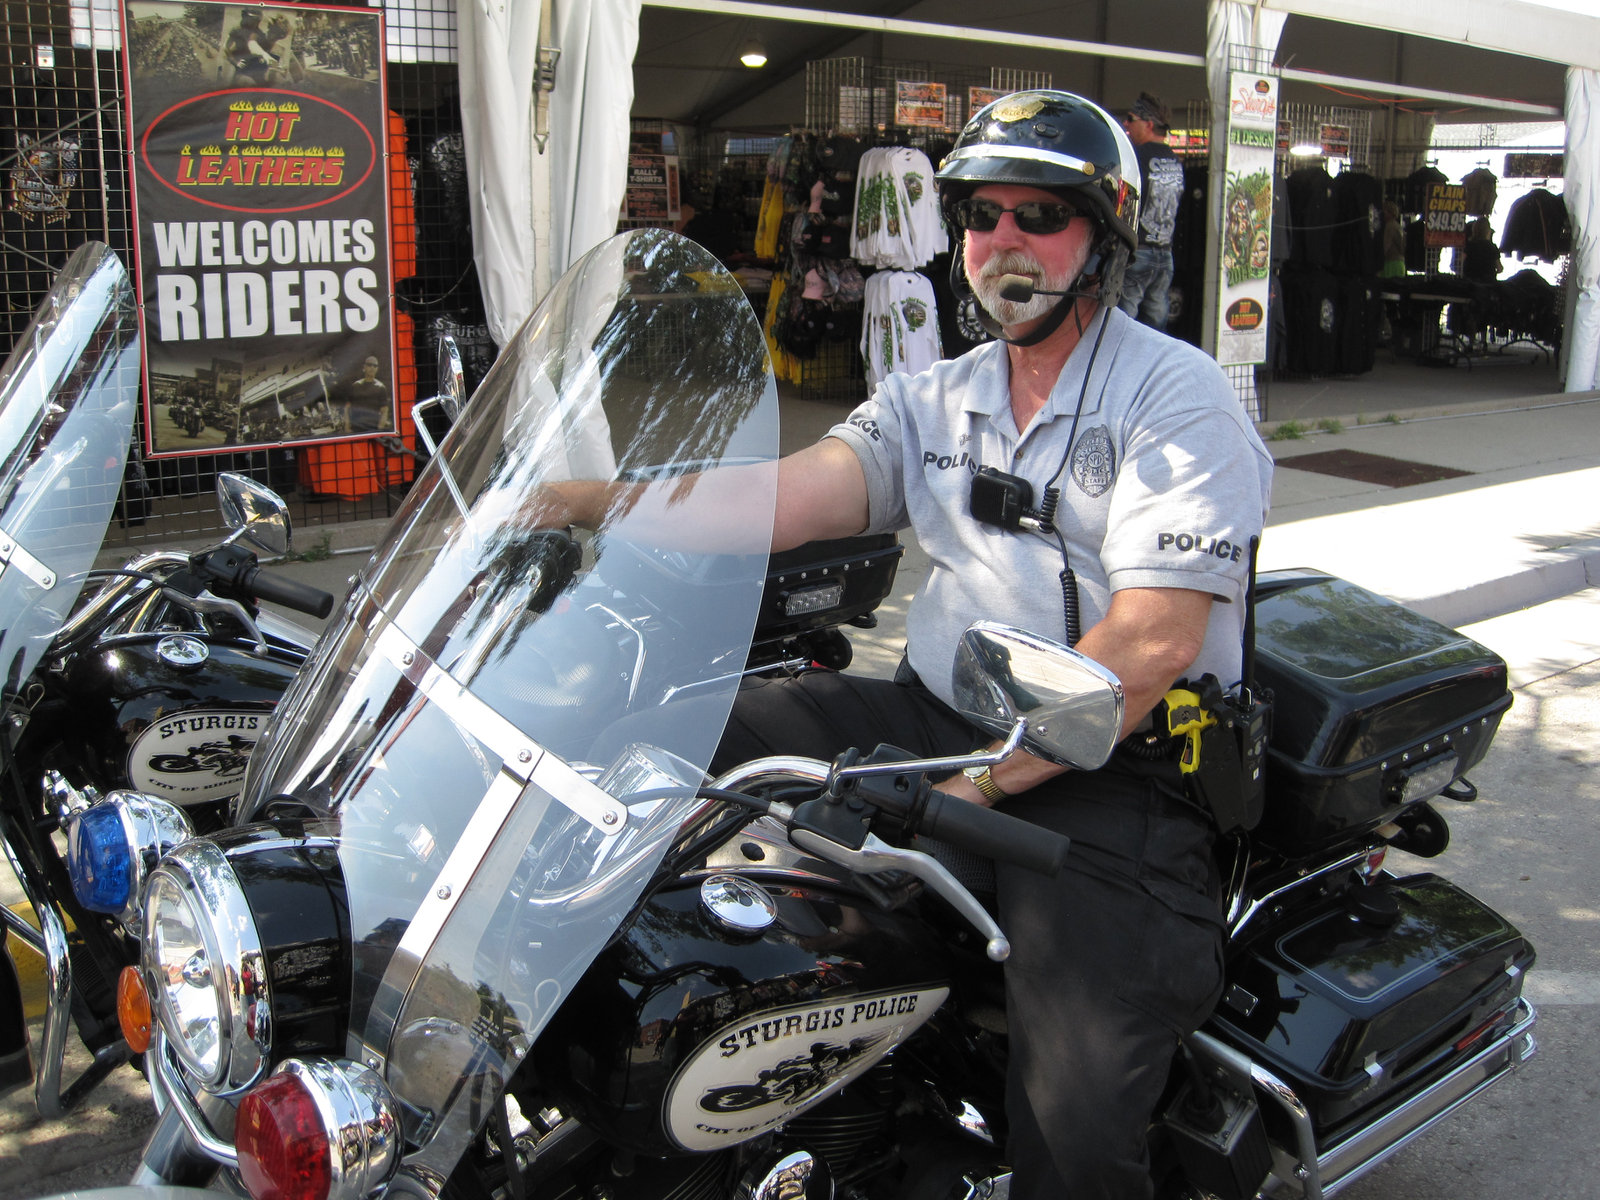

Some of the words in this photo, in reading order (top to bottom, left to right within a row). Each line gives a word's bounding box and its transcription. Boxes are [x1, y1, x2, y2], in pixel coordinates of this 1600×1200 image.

[224, 111, 301, 141] HOT
[176, 155, 345, 186] LEATHERS
[1429, 198, 1466, 212] CHAPS
[1432, 185, 1465, 198] PLAIN
[1427, 211, 1466, 232] $49.95
[153, 219, 376, 267] WELCOMES
[157, 267, 380, 342] RIDERS
[1158, 532, 1242, 563] POLICE
[160, 716, 258, 739] STURGIS
[149, 778, 177, 790] CITY
[203, 777, 243, 790] RIDER
[719, 1007, 845, 1058] STURGIS
[851, 995, 918, 1023] POLICE
